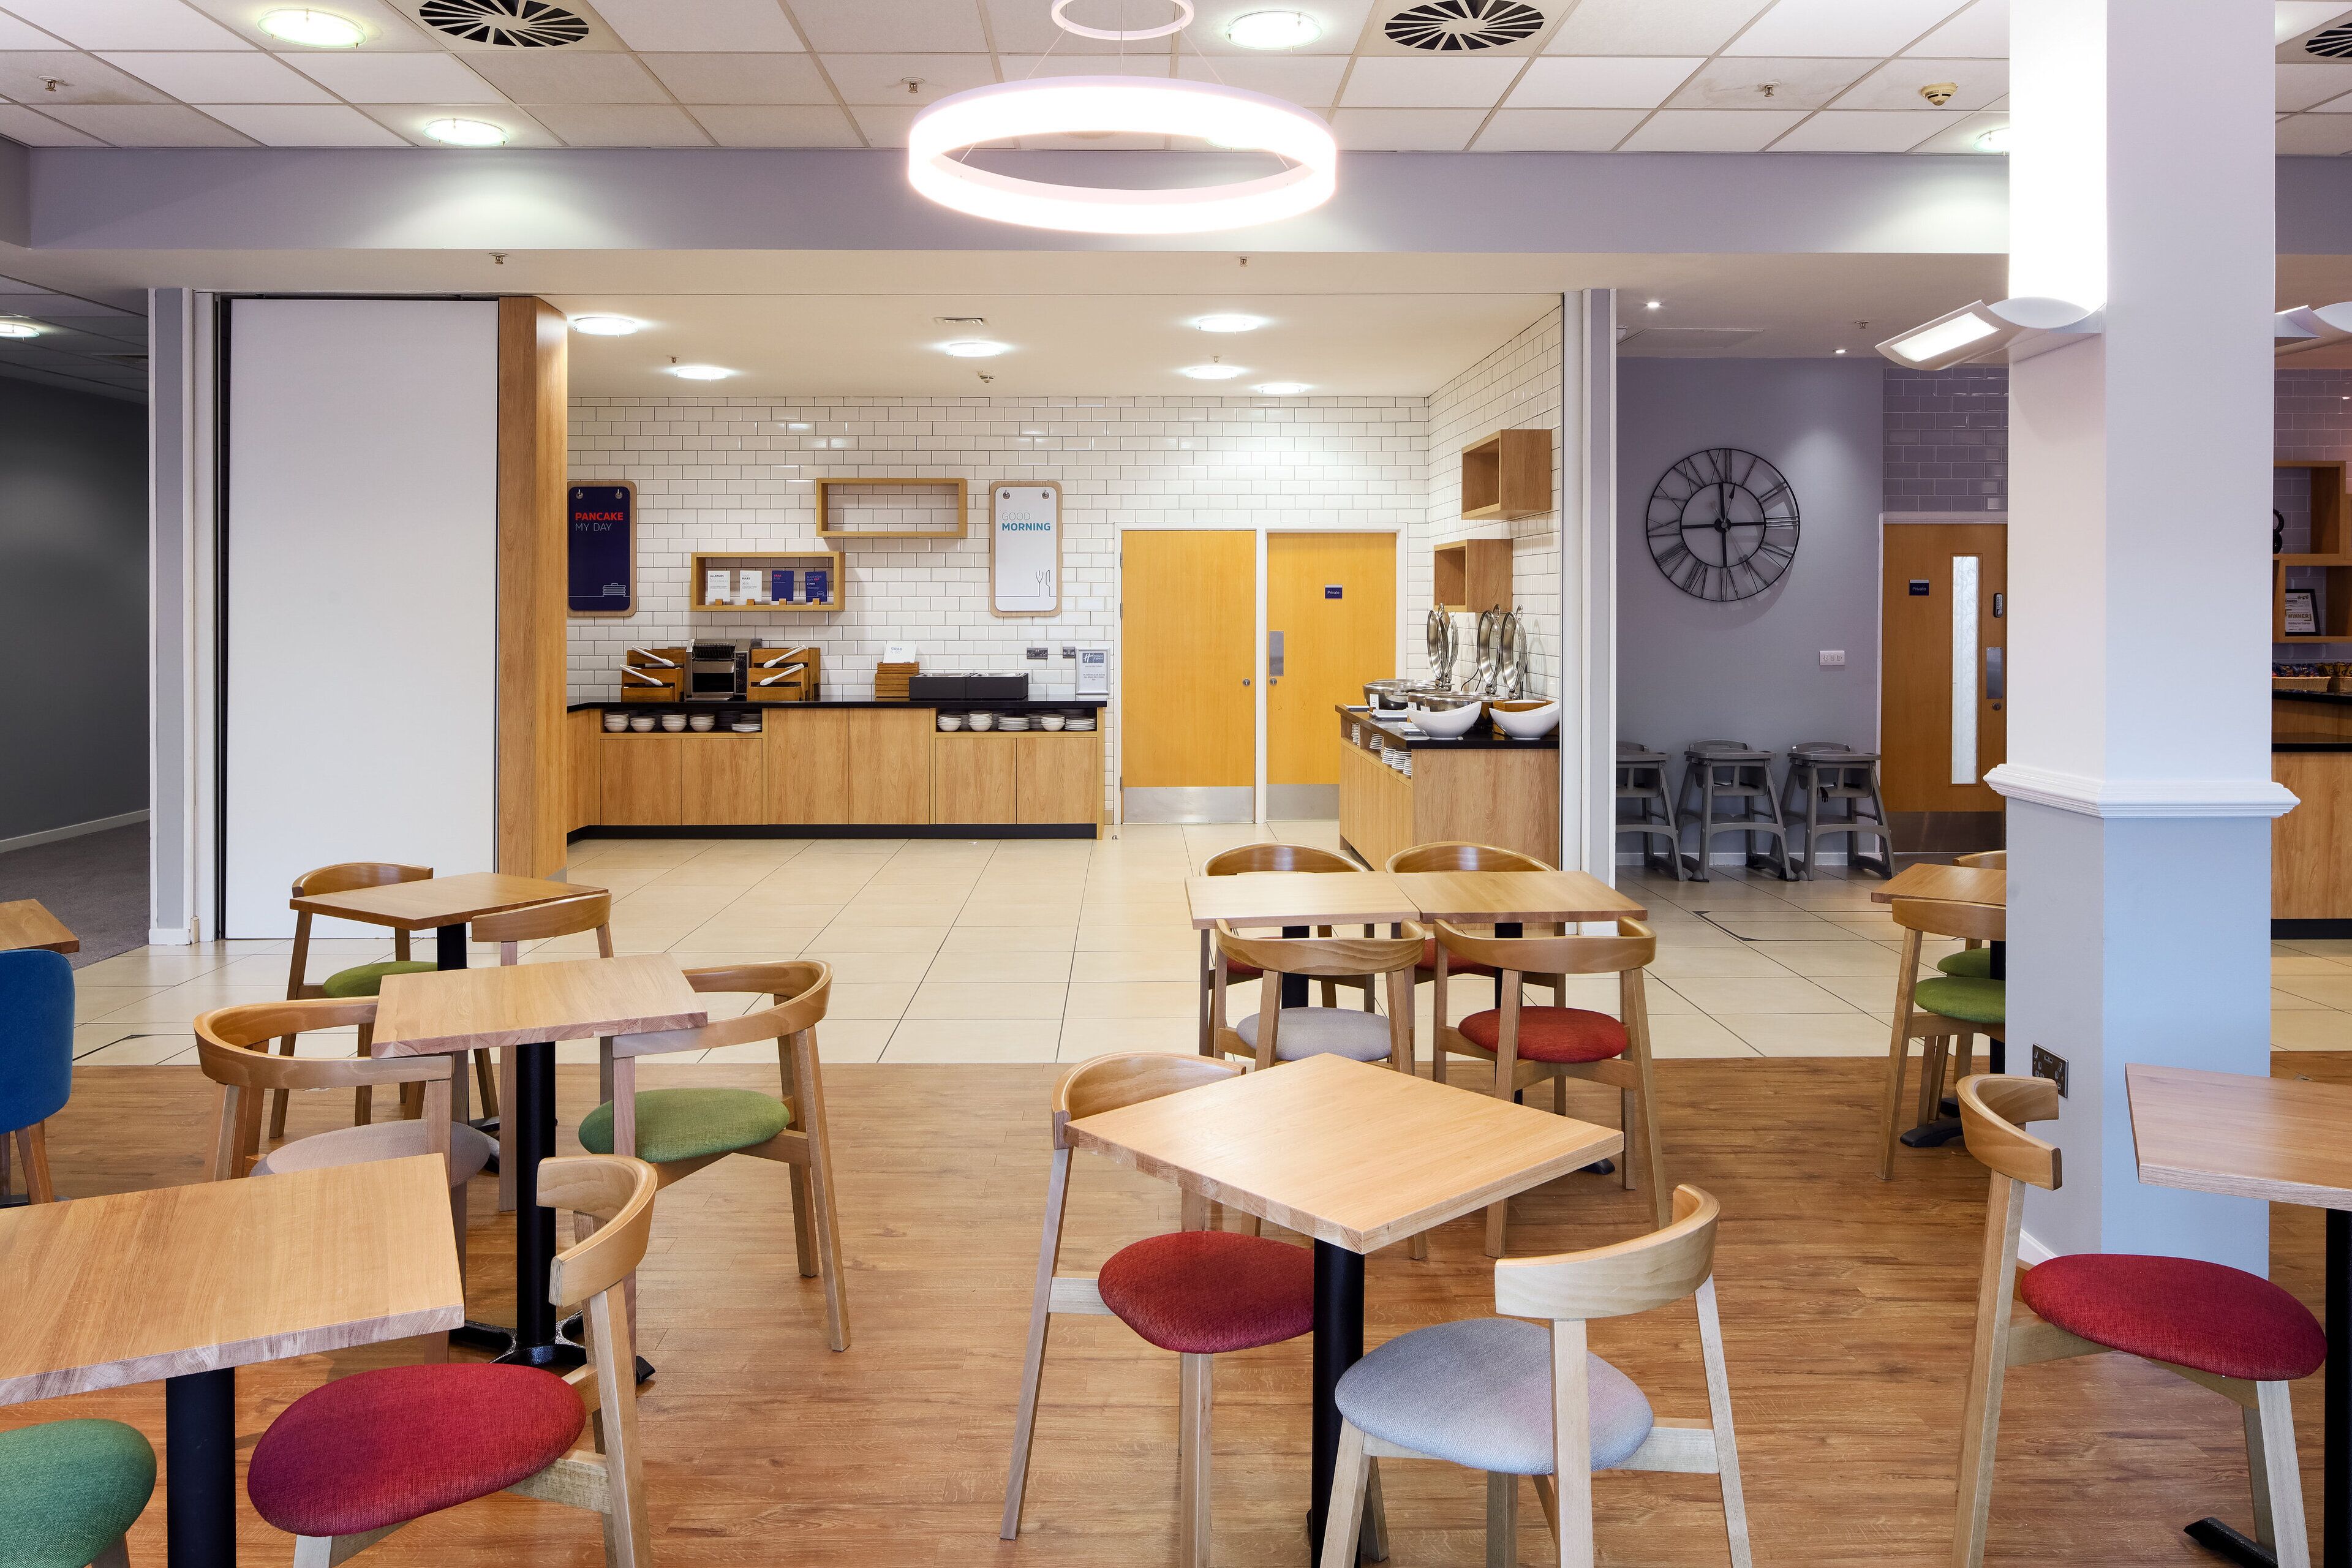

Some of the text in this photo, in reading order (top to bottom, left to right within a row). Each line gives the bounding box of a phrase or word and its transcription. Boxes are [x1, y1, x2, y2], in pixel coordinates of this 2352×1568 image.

[575, 512, 624, 521] PANCAKE
[1001, 512, 1031, 521] GOOD
[575, 522, 612, 532] MY DAY
[1001, 522, 1050, 531] MORNING
